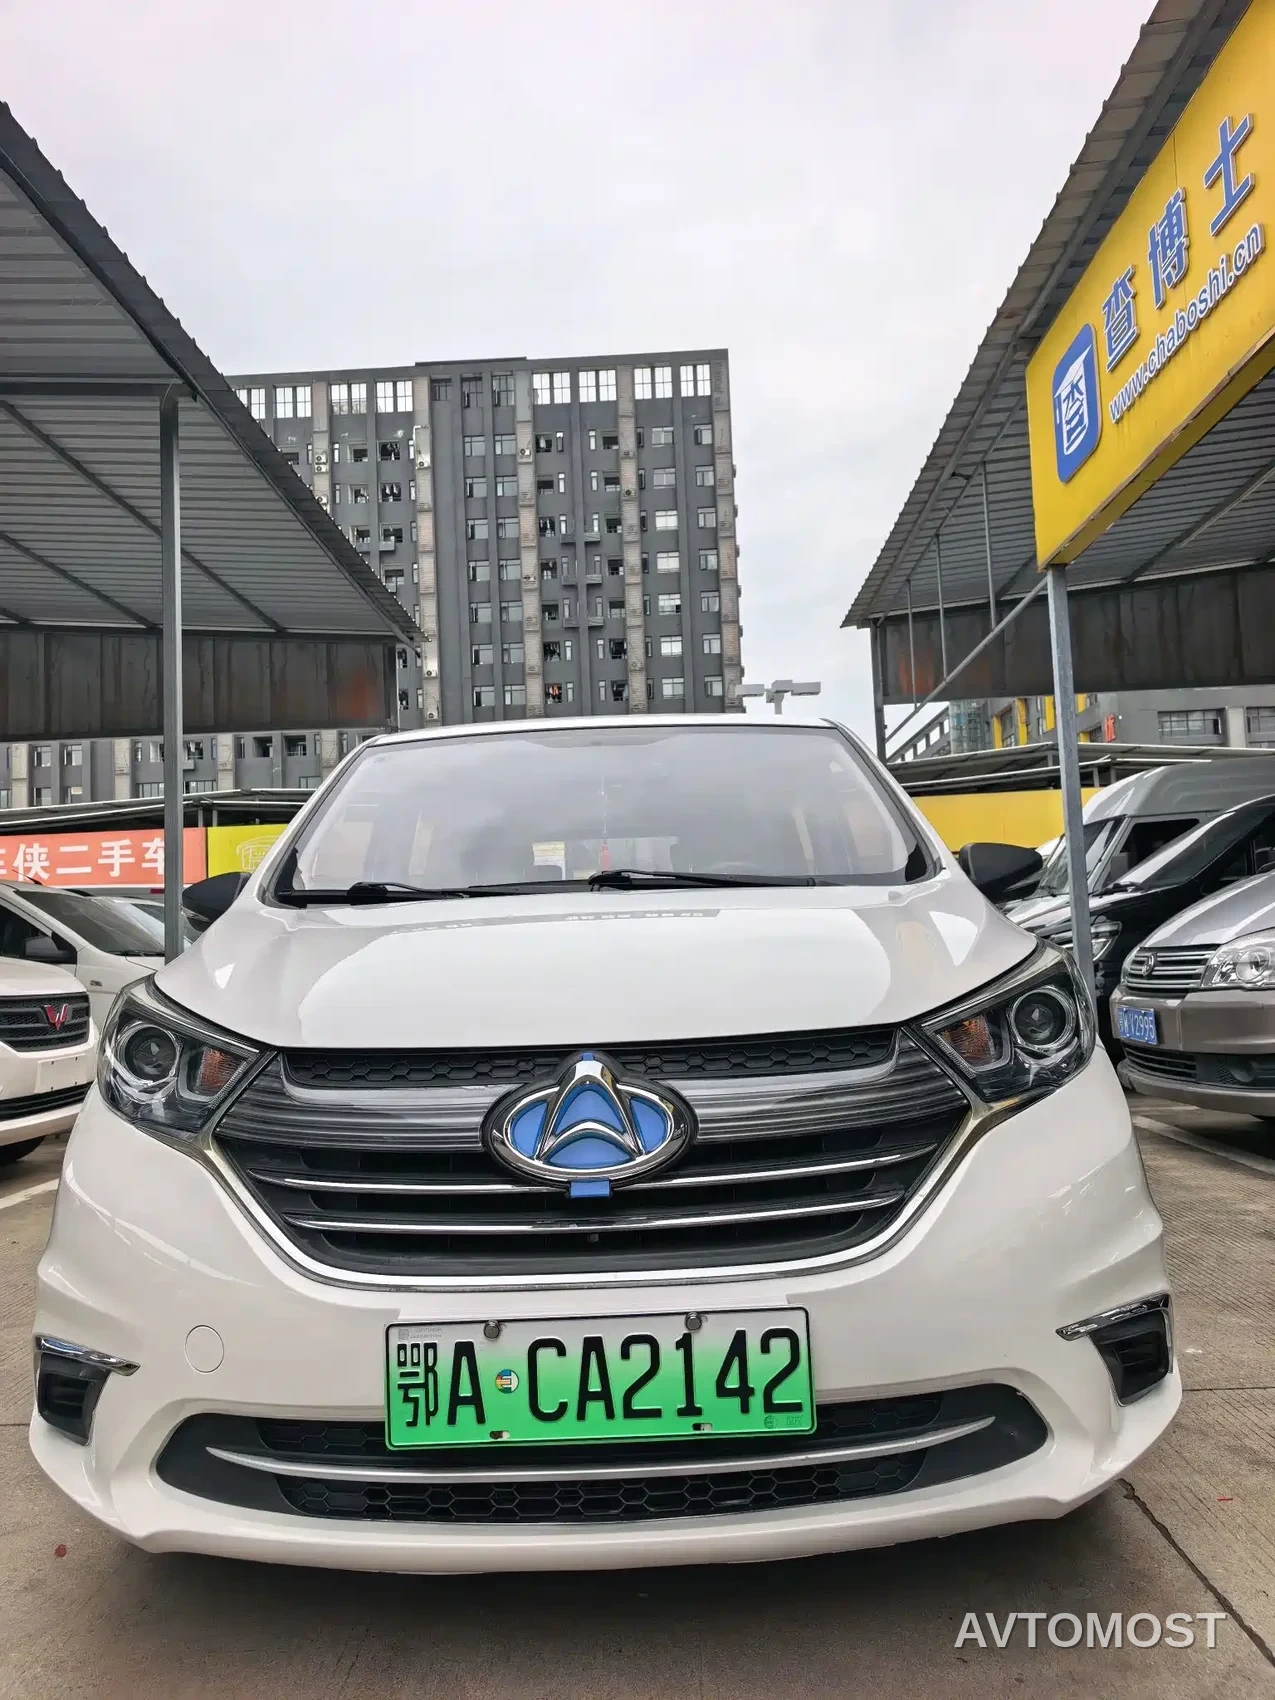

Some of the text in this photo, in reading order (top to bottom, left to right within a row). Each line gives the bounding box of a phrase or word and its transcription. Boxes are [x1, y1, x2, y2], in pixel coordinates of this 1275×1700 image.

[1101, 113, 1254, 373] 查博士
[1108, 223, 1264, 424] www.chaboshi.cn
[0, 837, 165, 881] 侠二手车
[397, 1328, 804, 1427] 鄂A CA2142
